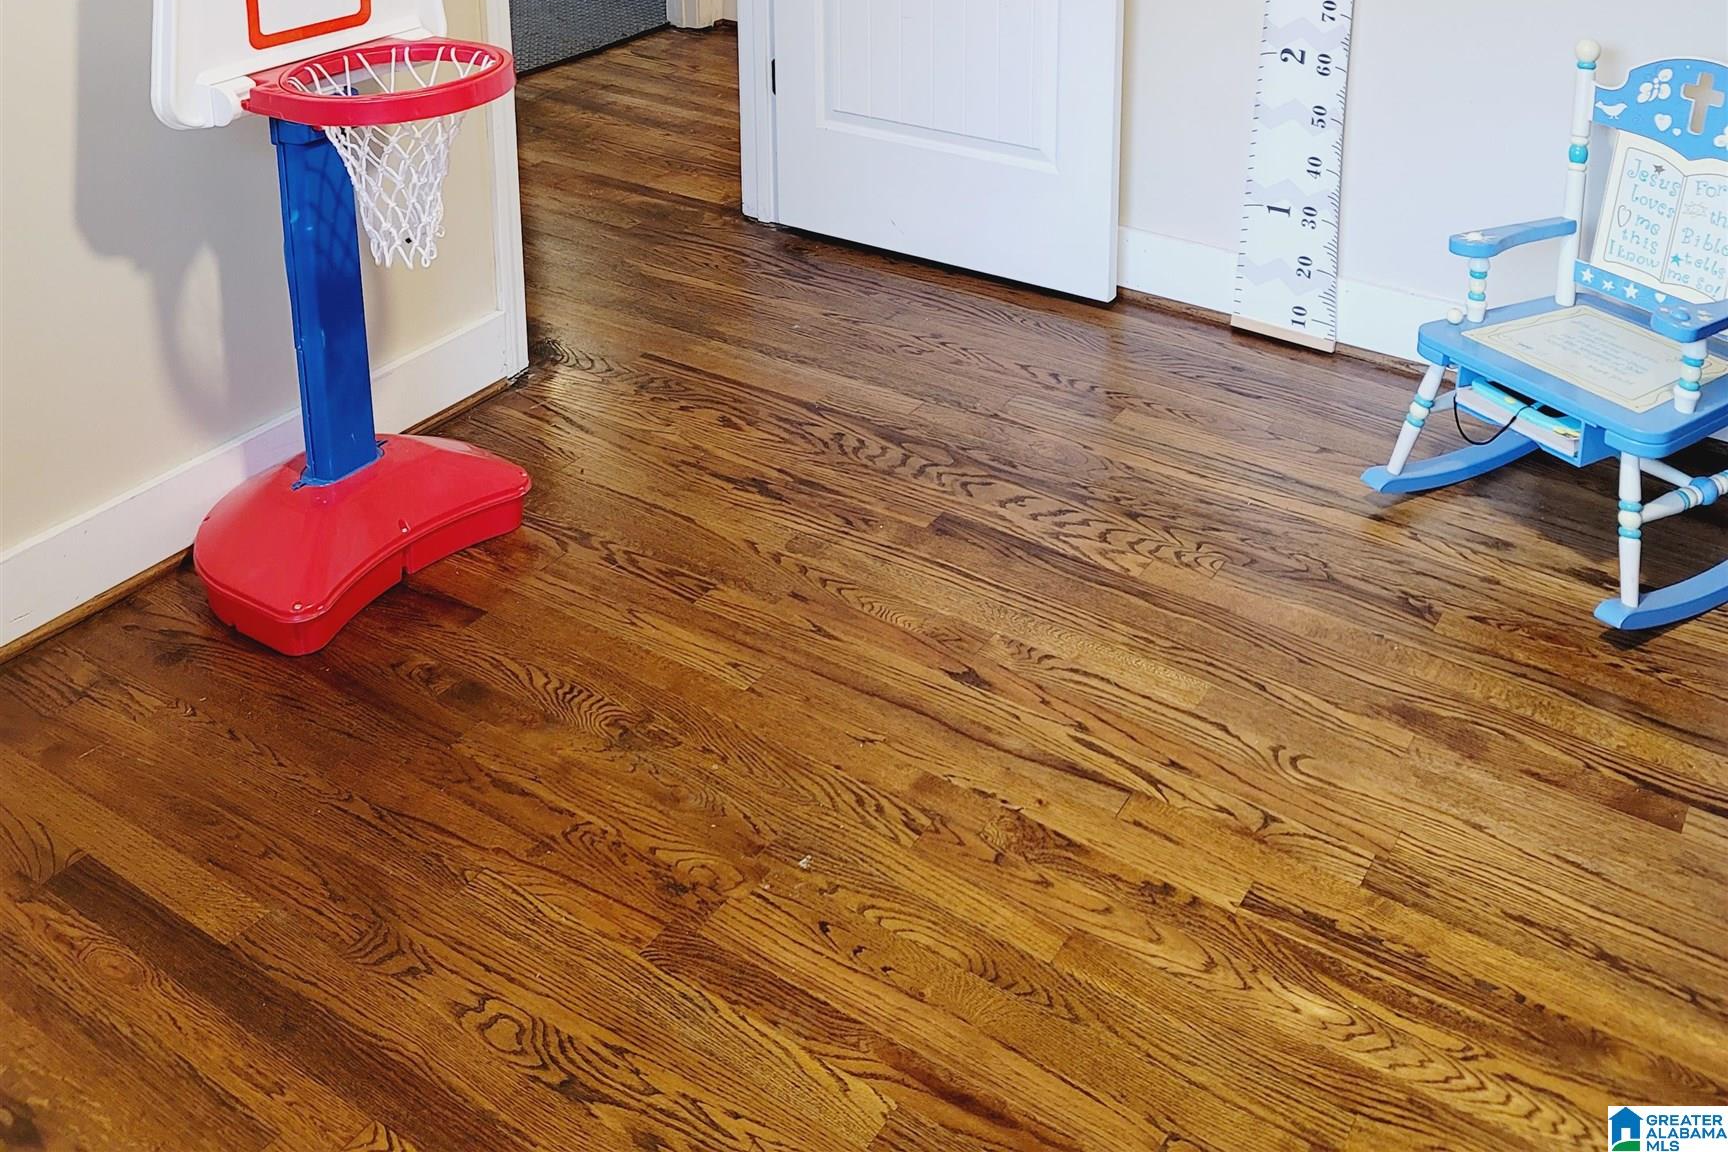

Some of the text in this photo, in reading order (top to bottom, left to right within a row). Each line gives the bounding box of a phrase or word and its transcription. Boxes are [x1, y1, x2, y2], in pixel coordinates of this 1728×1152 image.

[1321, 0, 1338, 22] 70
[1281, 47, 1306, 66] 2
[1316, 53, 1333, 77] 60
[1310, 104, 1328, 129] 50
[1305, 156, 1323, 179] 40
[1627, 159, 1681, 197] Jesus
[1696, 180, 1728, 198] For
[1266, 201, 1292, 217] 1
[1300, 206, 1318, 230] 30
[1636, 214, 1661, 236] me
[1622, 230, 1659, 255] this
[1295, 255, 1312, 280] 20
[1616, 245, 1660, 268] know
[1685, 252, 1726, 280] tells
[1667, 268, 1691, 284] me
[1290, 305, 1307, 329] 10
